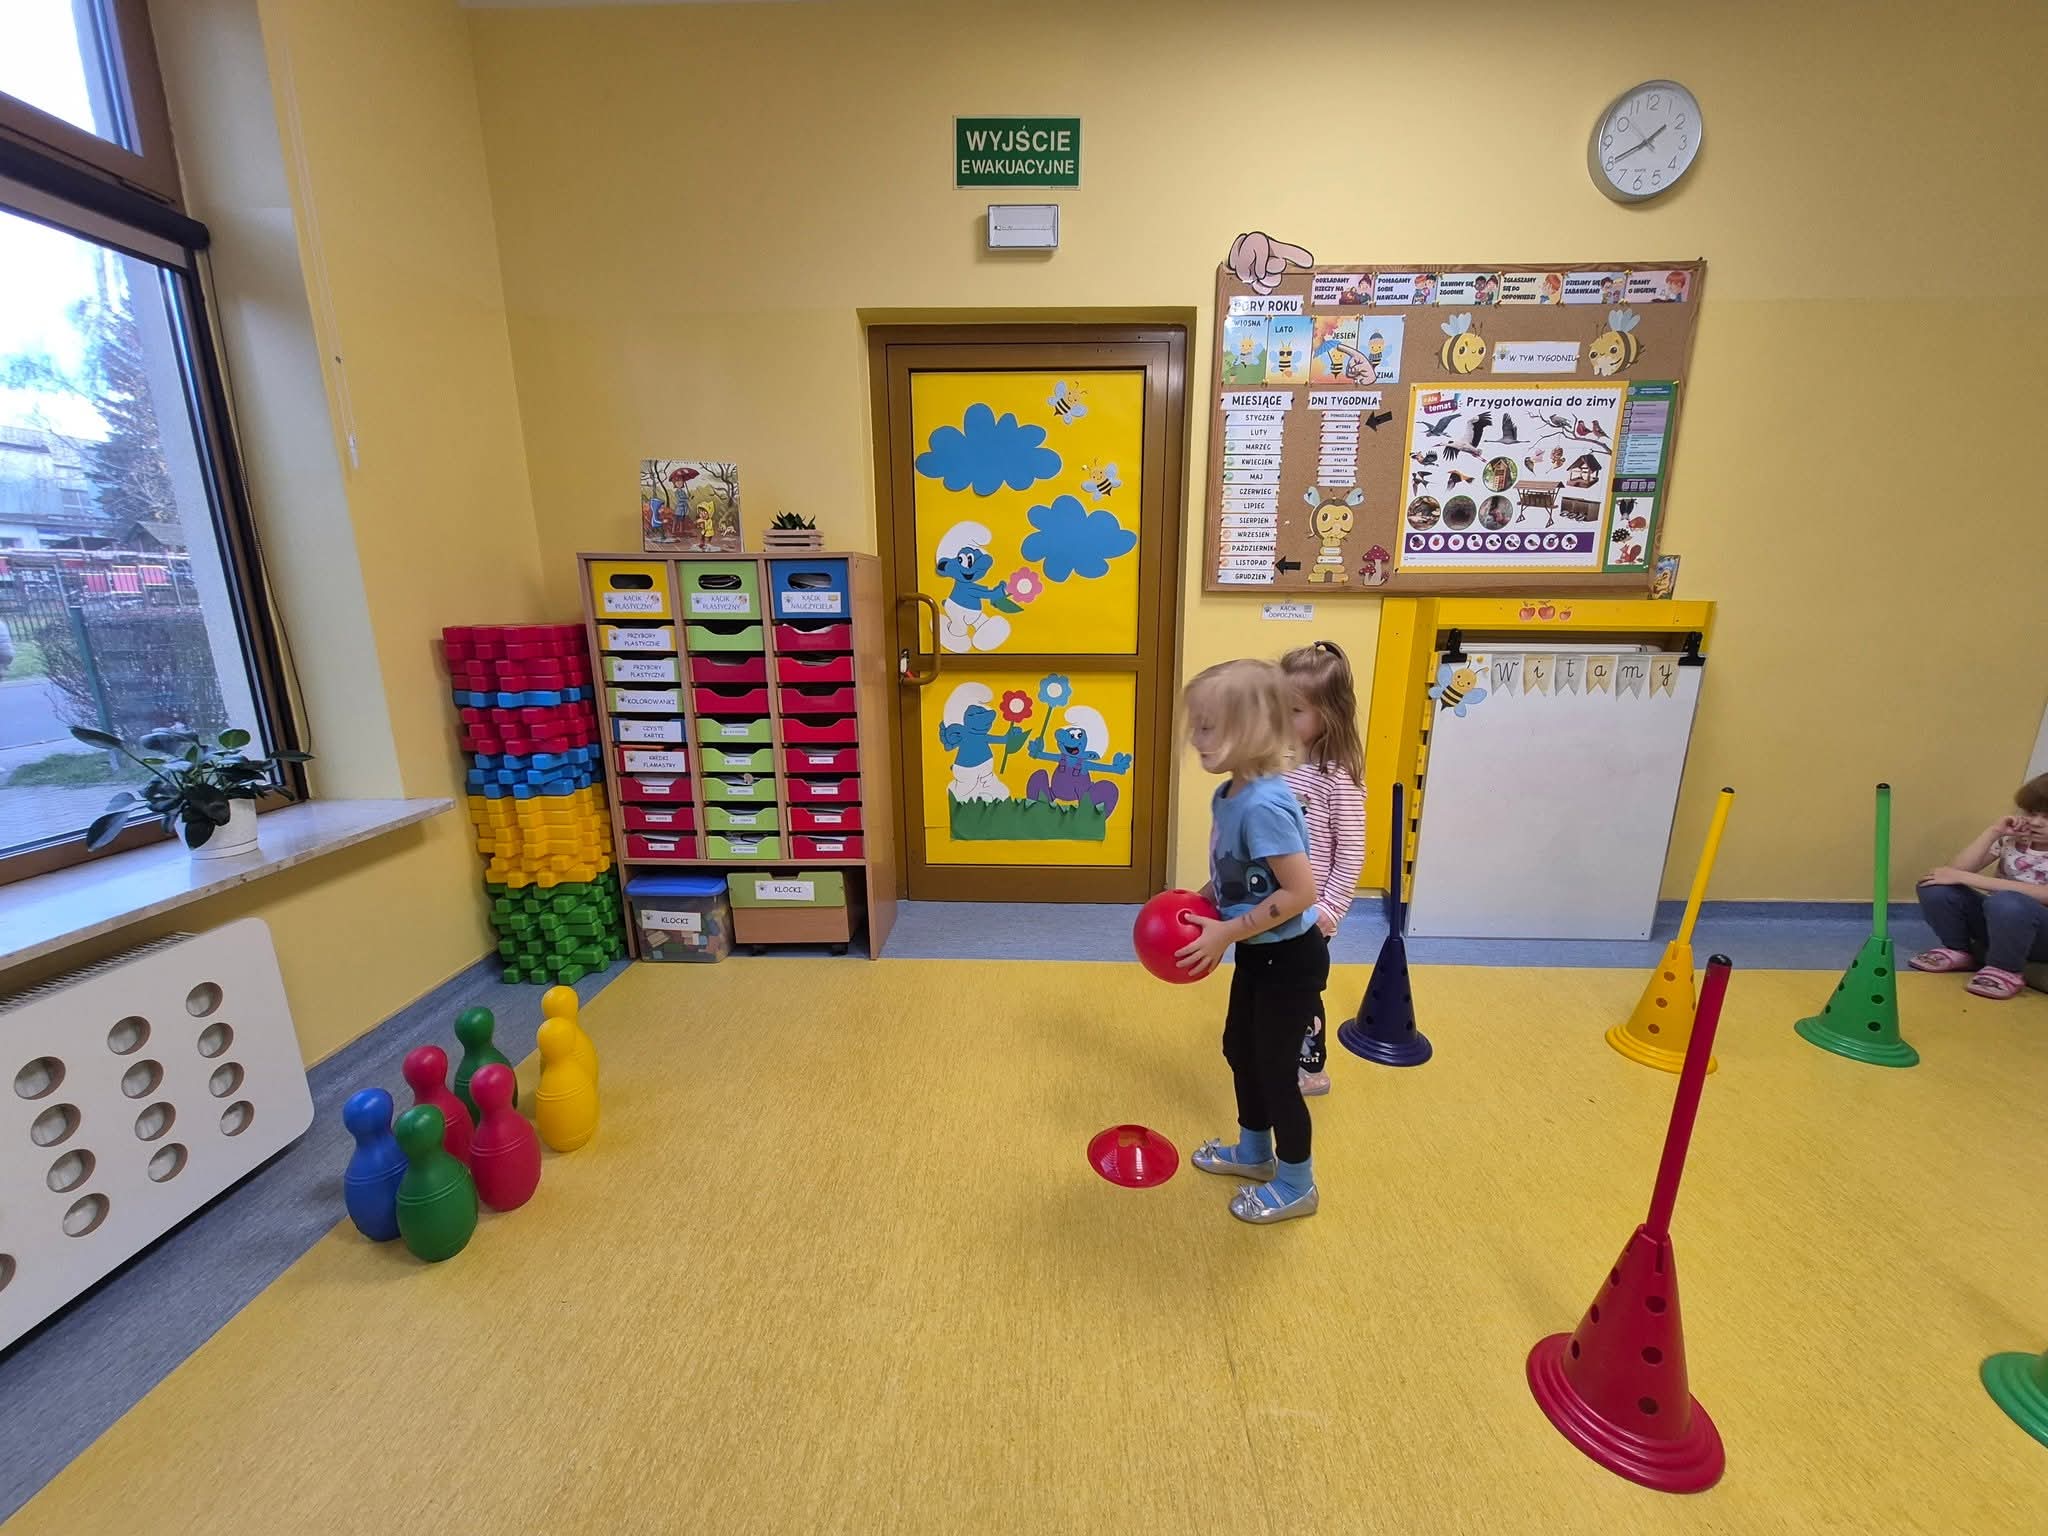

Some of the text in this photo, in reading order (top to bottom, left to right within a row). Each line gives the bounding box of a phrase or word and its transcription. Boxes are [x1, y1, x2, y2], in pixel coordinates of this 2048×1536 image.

[1629, 100, 1640, 116] 11
[1646, 94, 1660, 111] 12
[1674, 113, 1686, 130] 2
[966, 125, 1071, 152] WYJŚCIE
[1602, 134, 1614, 151] 9
[1679, 134, 1688, 151] 3
[961, 159, 1075, 175] EWAKUACYJNE
[1667, 155, 1677, 169] 4
[1616, 168, 1628, 184] 7
[1632, 174, 1642, 191] 6
[1651, 170, 1661, 185] 5
[1268, 300, 1298, 312] ROKU
[1520, 354, 1534, 362] TYM
[1537, 354, 1577, 362] TYGODNIU
[1376, 371, 1394, 379] ZIMA
[1232, 395, 1282, 408] MIESIĄCE
[1311, 396, 1378, 406] DNI TYGODNIA
[1429, 401, 1452, 412] temat
[1466, 396, 1616, 410] Przygotowania do zimy
[661, 916, 689, 925] KLOCKI
